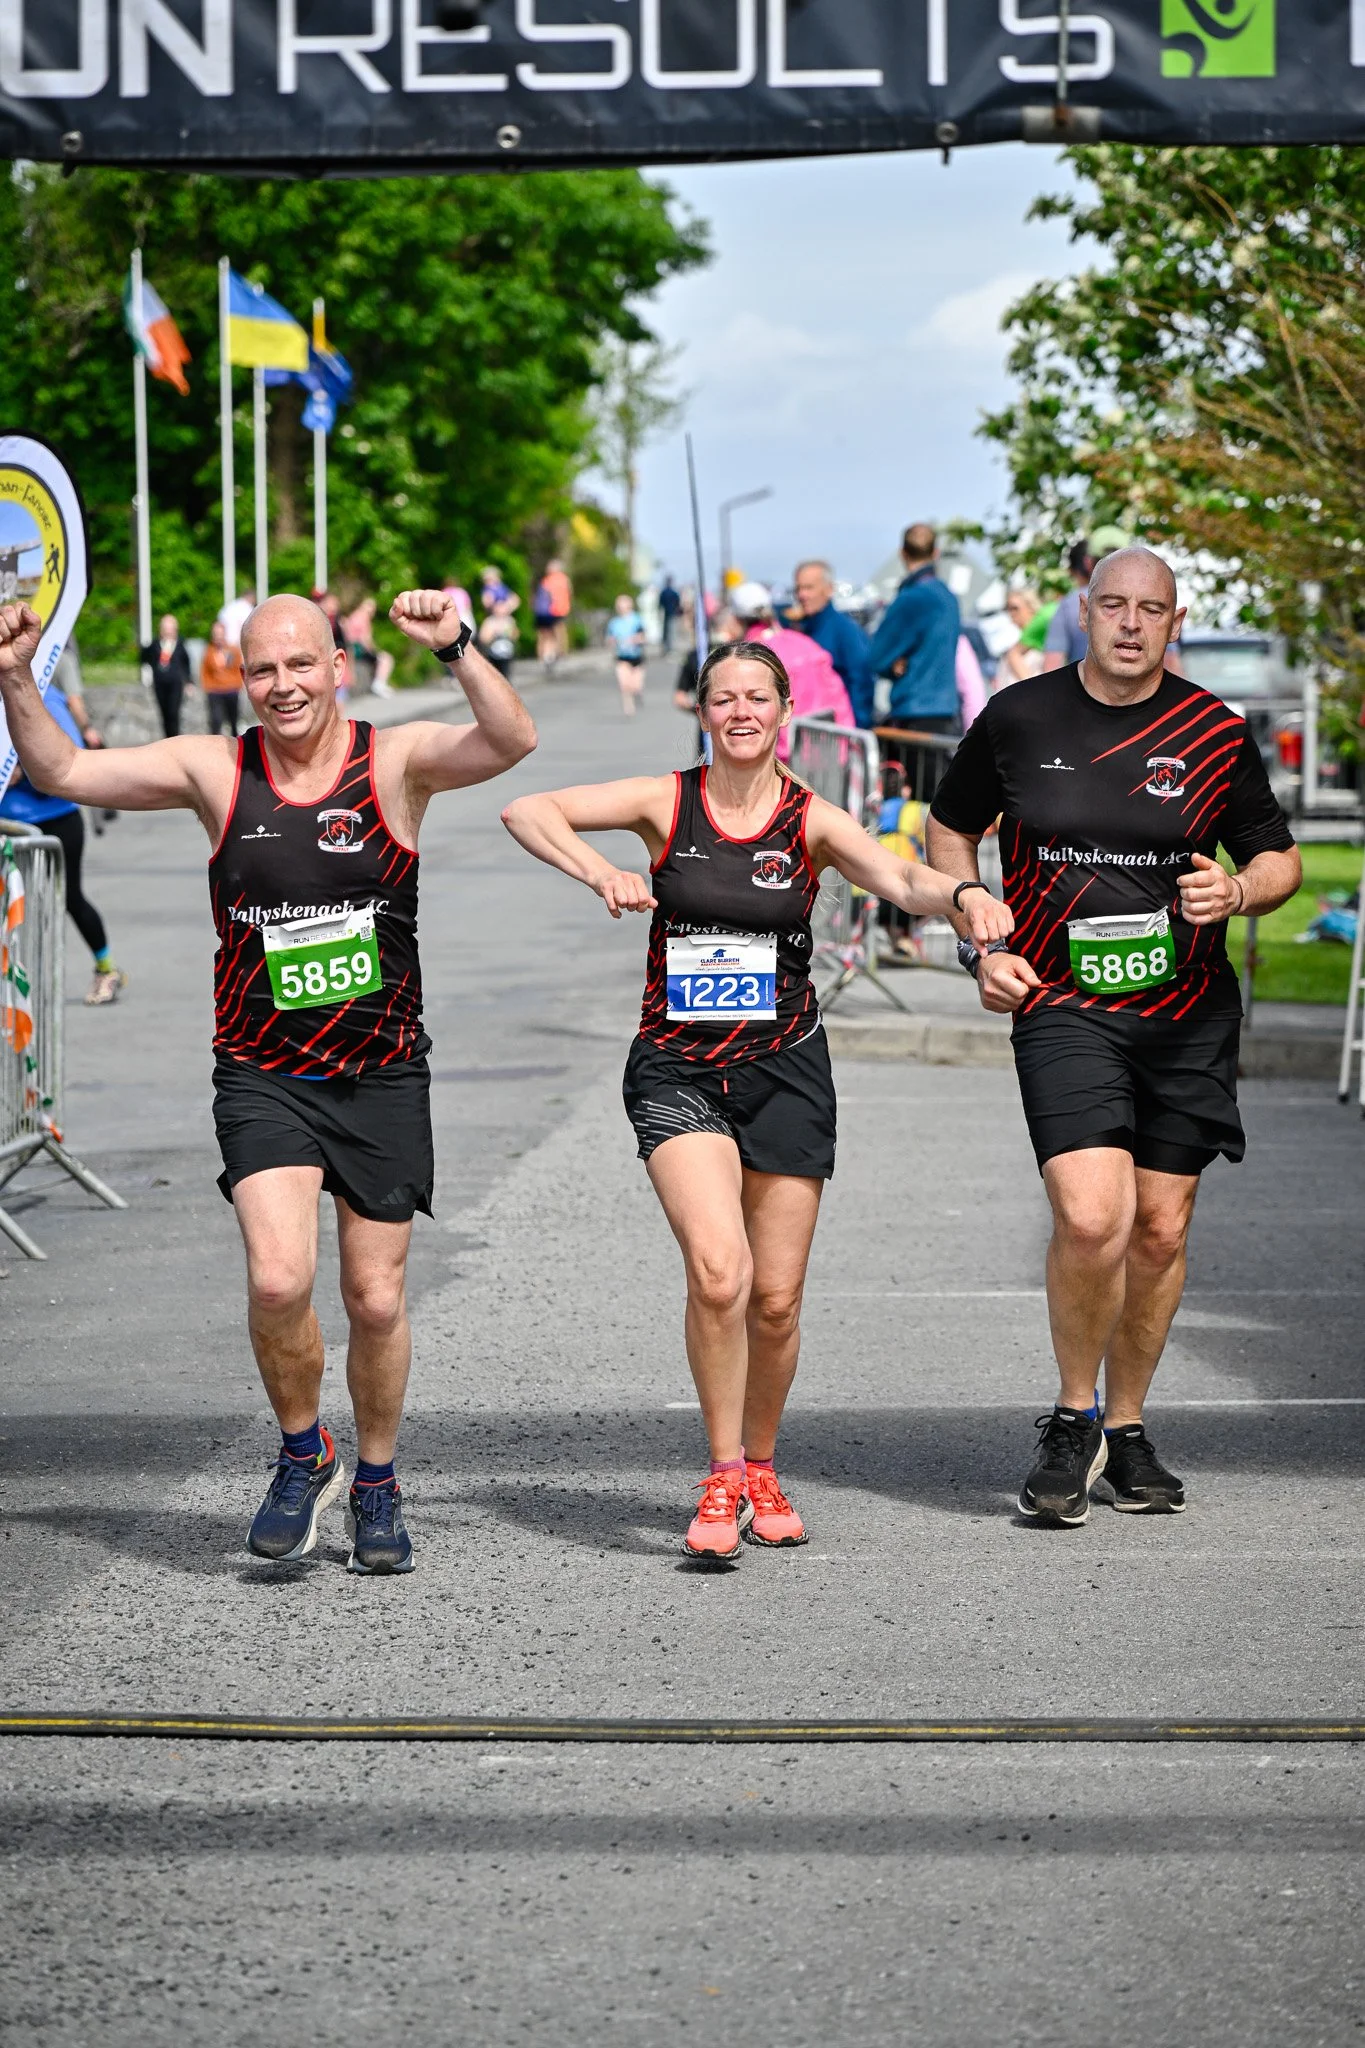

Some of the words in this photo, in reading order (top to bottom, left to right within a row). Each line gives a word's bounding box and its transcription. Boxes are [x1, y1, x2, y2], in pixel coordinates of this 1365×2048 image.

[1037, 846, 1158, 866] Ballyskenach
[1161, 852, 1190, 866] AC
[228, 899, 354, 928] Ballyskenach
[280, 951, 373, 999] 5859
[1080, 946, 1168, 985] 5868
[679, 976, 760, 1008] 1223
